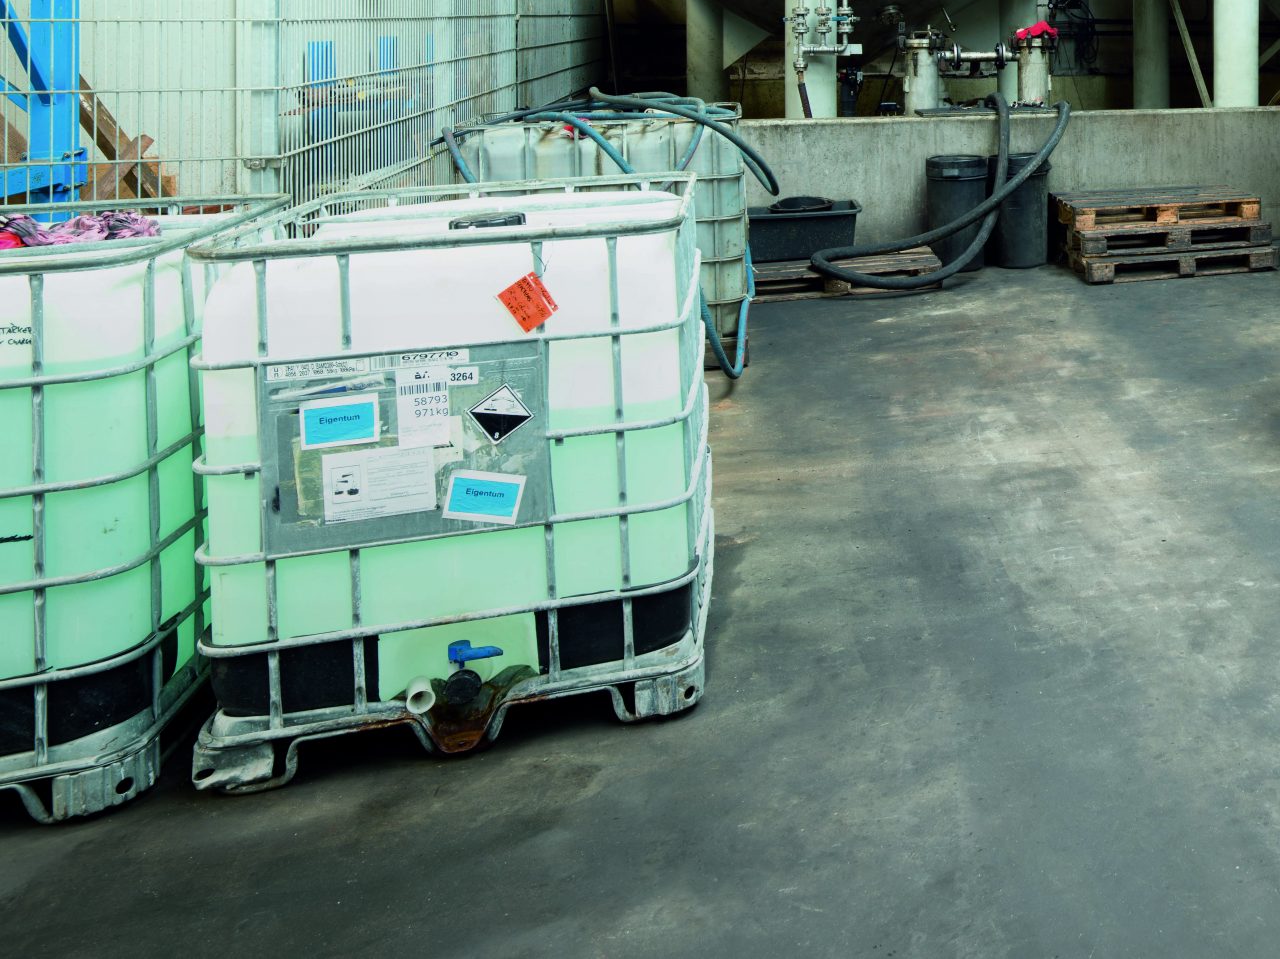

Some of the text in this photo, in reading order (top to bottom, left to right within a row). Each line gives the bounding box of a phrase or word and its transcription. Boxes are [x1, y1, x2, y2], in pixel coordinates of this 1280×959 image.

[401, 350, 459, 361] 6797710
[450, 372, 473, 382] 3264
[414, 394, 448, 407] 58793
[414, 407, 449, 418] 971kg
[319, 414, 360, 425] Eigentum
[465, 487, 505, 498] Eigentum
